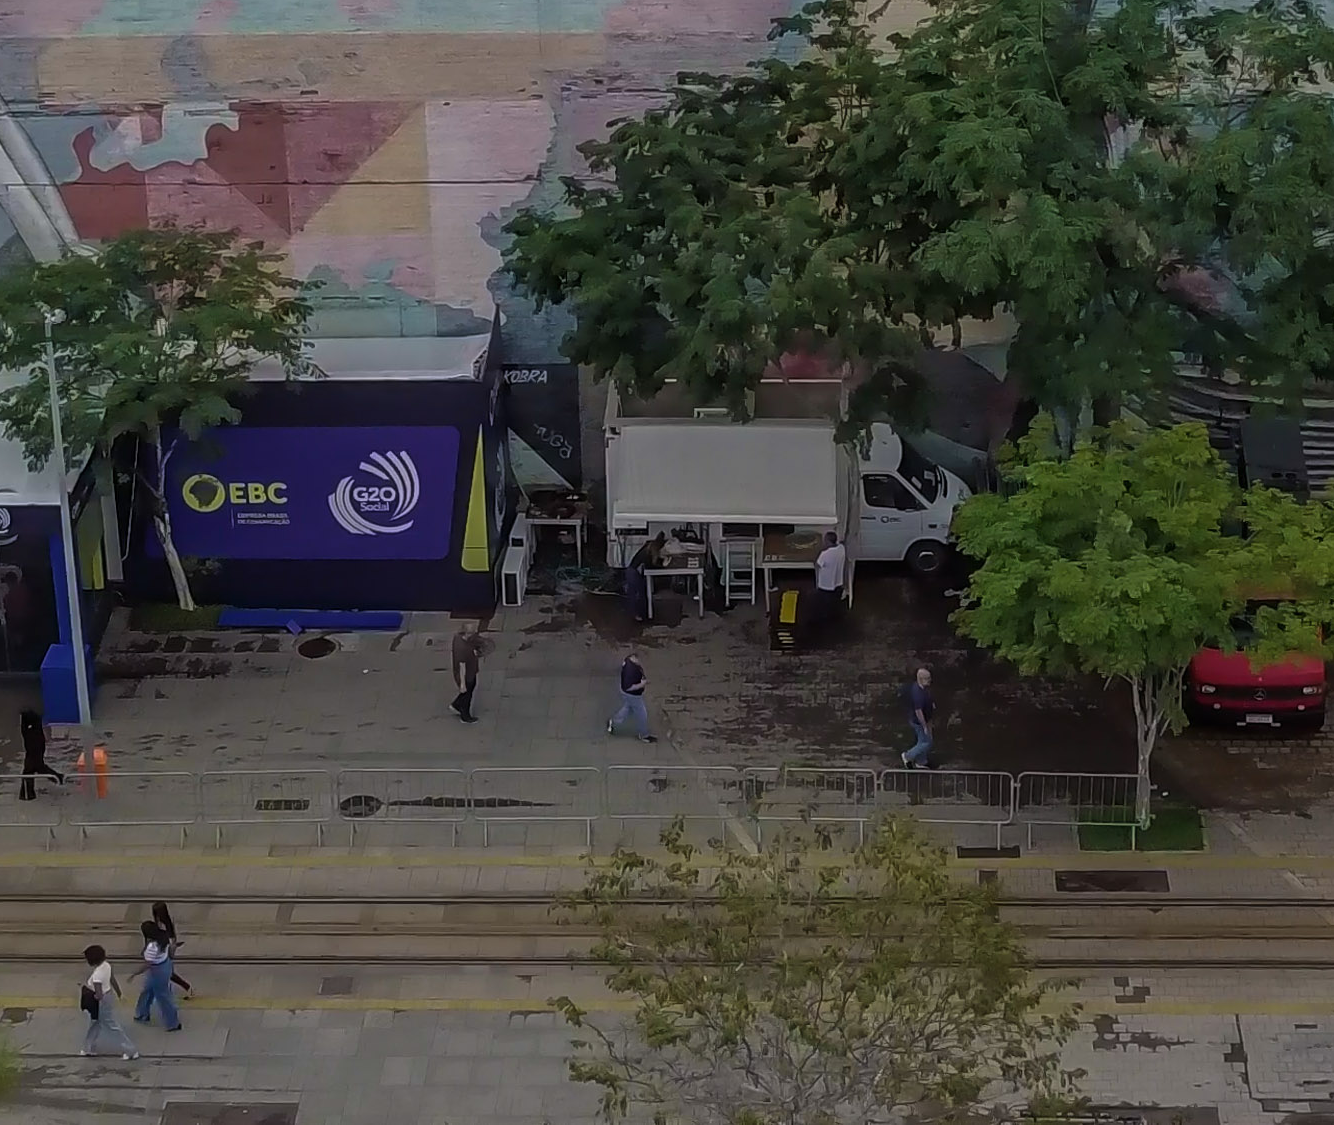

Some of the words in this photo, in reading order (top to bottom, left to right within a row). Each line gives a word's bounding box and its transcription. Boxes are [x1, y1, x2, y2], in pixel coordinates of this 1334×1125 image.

[503, 369, 548, 384] KOBRA
[229, 482, 288, 504] EBC
[353, 486, 396, 502] G20
